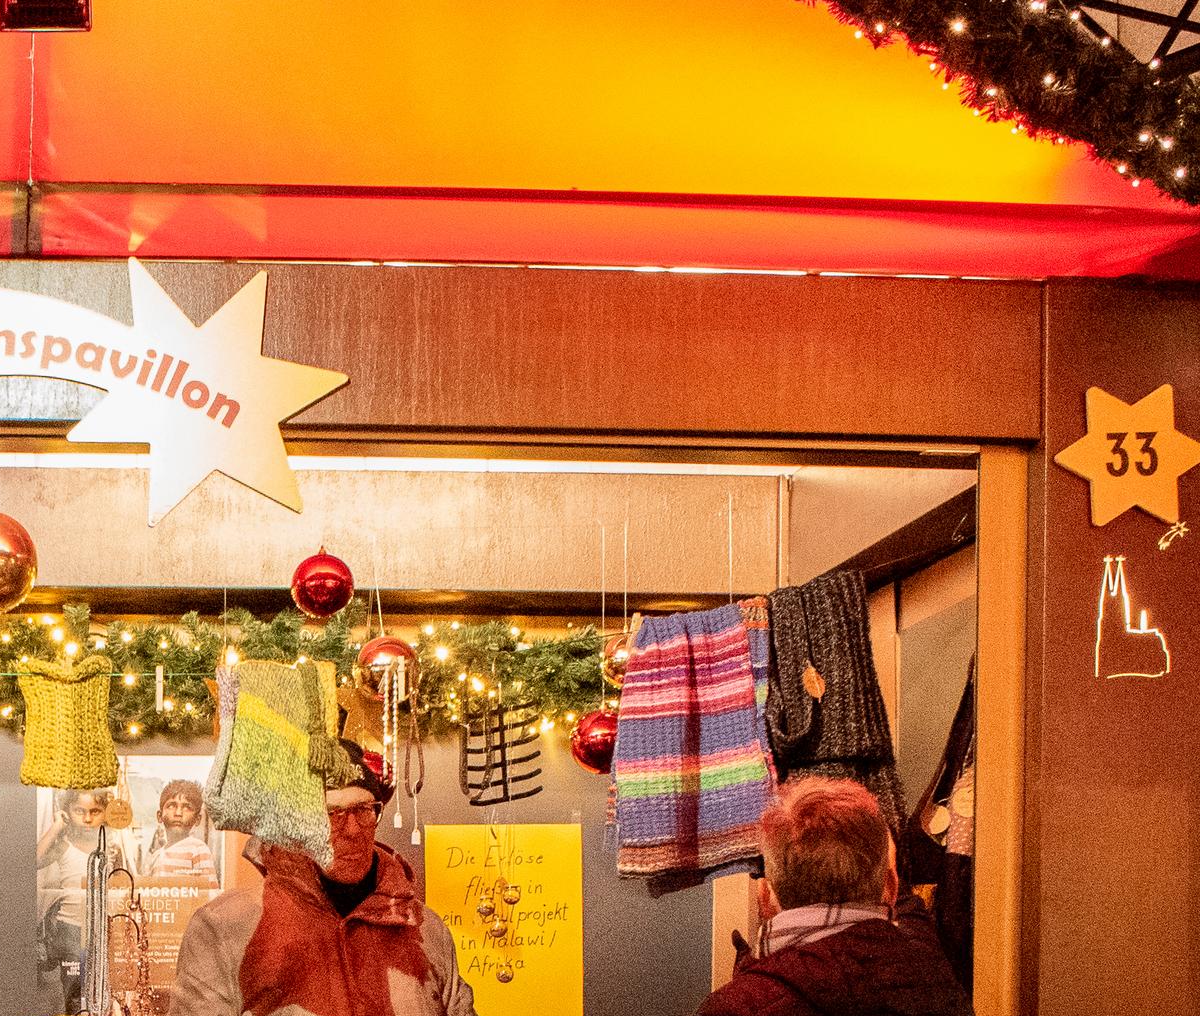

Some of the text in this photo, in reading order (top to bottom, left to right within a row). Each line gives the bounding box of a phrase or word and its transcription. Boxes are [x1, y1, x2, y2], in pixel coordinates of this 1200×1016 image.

[1106, 431, 1159, 477] 33
[446, 845, 544, 869] Die Erlöse
[140, 886, 199, 898] MORGEN
[464, 876, 543, 905] fließ in
[443, 911, 462, 926] ein
[461, 935, 476, 950] in
